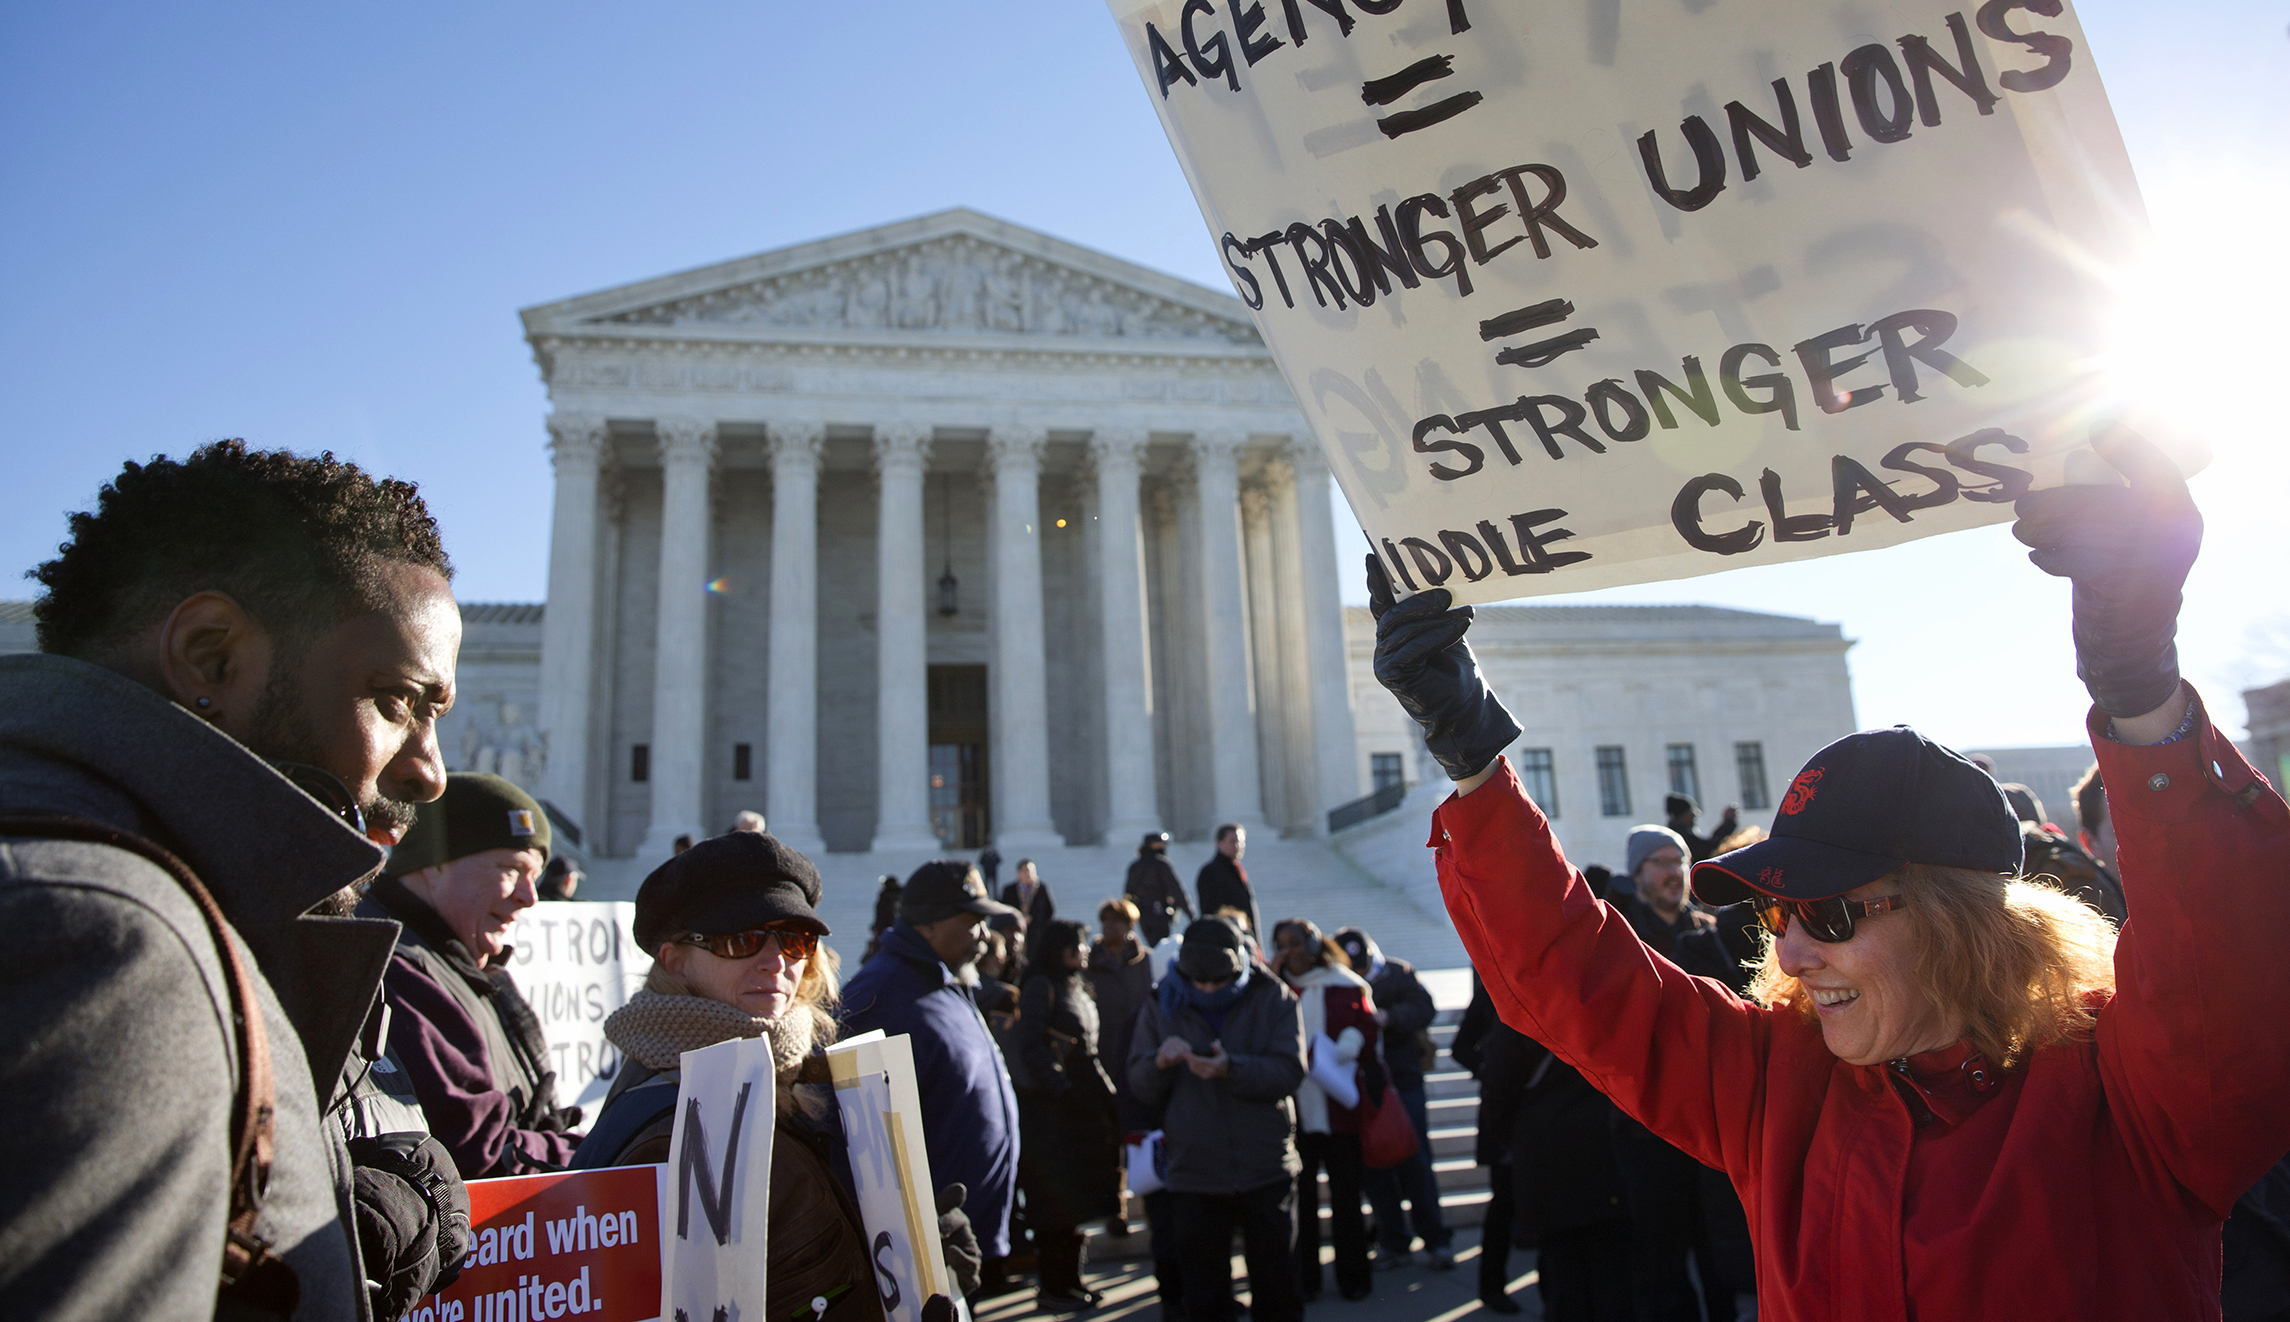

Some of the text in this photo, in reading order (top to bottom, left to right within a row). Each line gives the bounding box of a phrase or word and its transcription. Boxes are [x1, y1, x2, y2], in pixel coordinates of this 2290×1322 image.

[1222, 164, 1599, 311] STRONGER
[1637, 0, 2073, 212] UNIONS
[1412, 309, 1991, 481] STRONGER
[1363, 427, 2034, 594] IDDLE CLASS
[473, 1266, 603, 1322] united.
[546, 1205, 638, 1256] when
